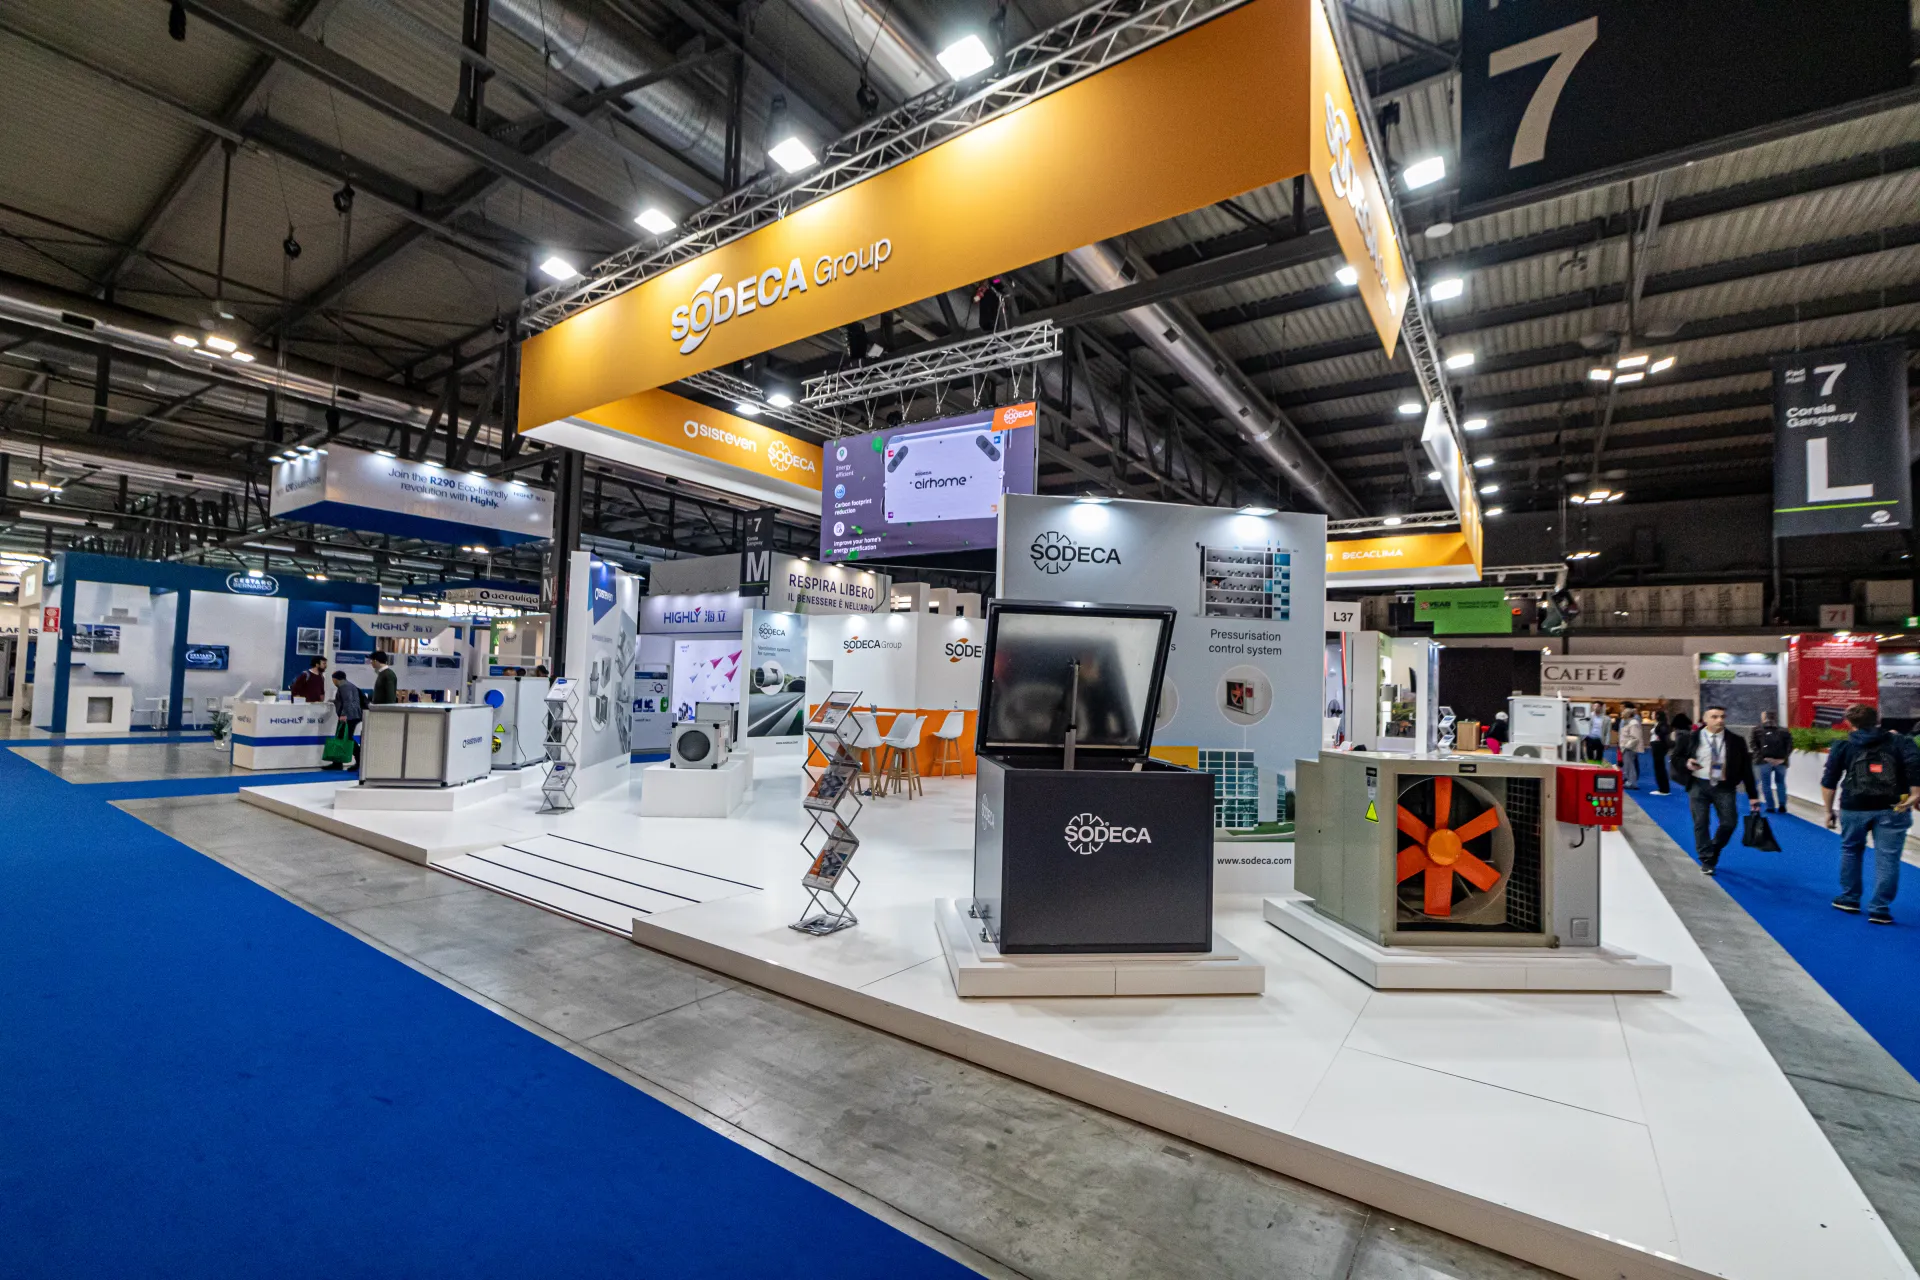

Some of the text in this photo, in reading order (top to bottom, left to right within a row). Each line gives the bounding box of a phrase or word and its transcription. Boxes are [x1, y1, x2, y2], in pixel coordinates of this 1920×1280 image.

[1489, 15, 1598, 169] 7
[671, 238, 892, 341] SODECA Group
[1813, 363, 1847, 397] 7
[1004, 410, 1033, 419] SODECA
[1786, 404, 1836, 418] Corsia
[1786, 412, 1858, 428] Gangway
[699, 424, 757, 452] sisteven
[768, 449, 815, 472] SODECA
[836, 464, 851, 472] Energy
[1807, 437, 1874, 502] L
[388, 468, 410, 479] Join
[411, 473, 428, 483] the
[429, 476, 456, 489] R290
[457, 481, 509, 500] Eco-friendly
[915, 476, 967, 489] airhome
[400, 482, 448, 498] revolution
[449, 492, 469, 502] with
[470, 494, 500, 509] Highly.
[852, 498, 872, 506] footprint
[753, 517, 763, 533] 7
[1030, 543, 1121, 565] SODECA
[746, 551, 769, 582] M
[542, 577, 553, 602] N
[789, 573, 874, 599] RESPIRA LIBERO
[491, 592, 539, 605] aerauliqa
[788, 593, 874, 613] IL BENESSERE È NELL'ARIA
[663, 610, 728, 624] HIGHLY 海立
[1333, 612, 1353, 622] L37
[371, 622, 410, 632] HIGHLY
[758, 628, 786, 636] SODECA
[1210, 629, 1281, 642] Pressurisation
[844, 640, 902, 650] SODECA Group
[1209, 644, 1282, 657] control system
[1544, 665, 1609, 681] CAFFÈ
[1064, 826, 1151, 844] SODECA
[1217, 857, 1292, 865] www.sodeca.com
